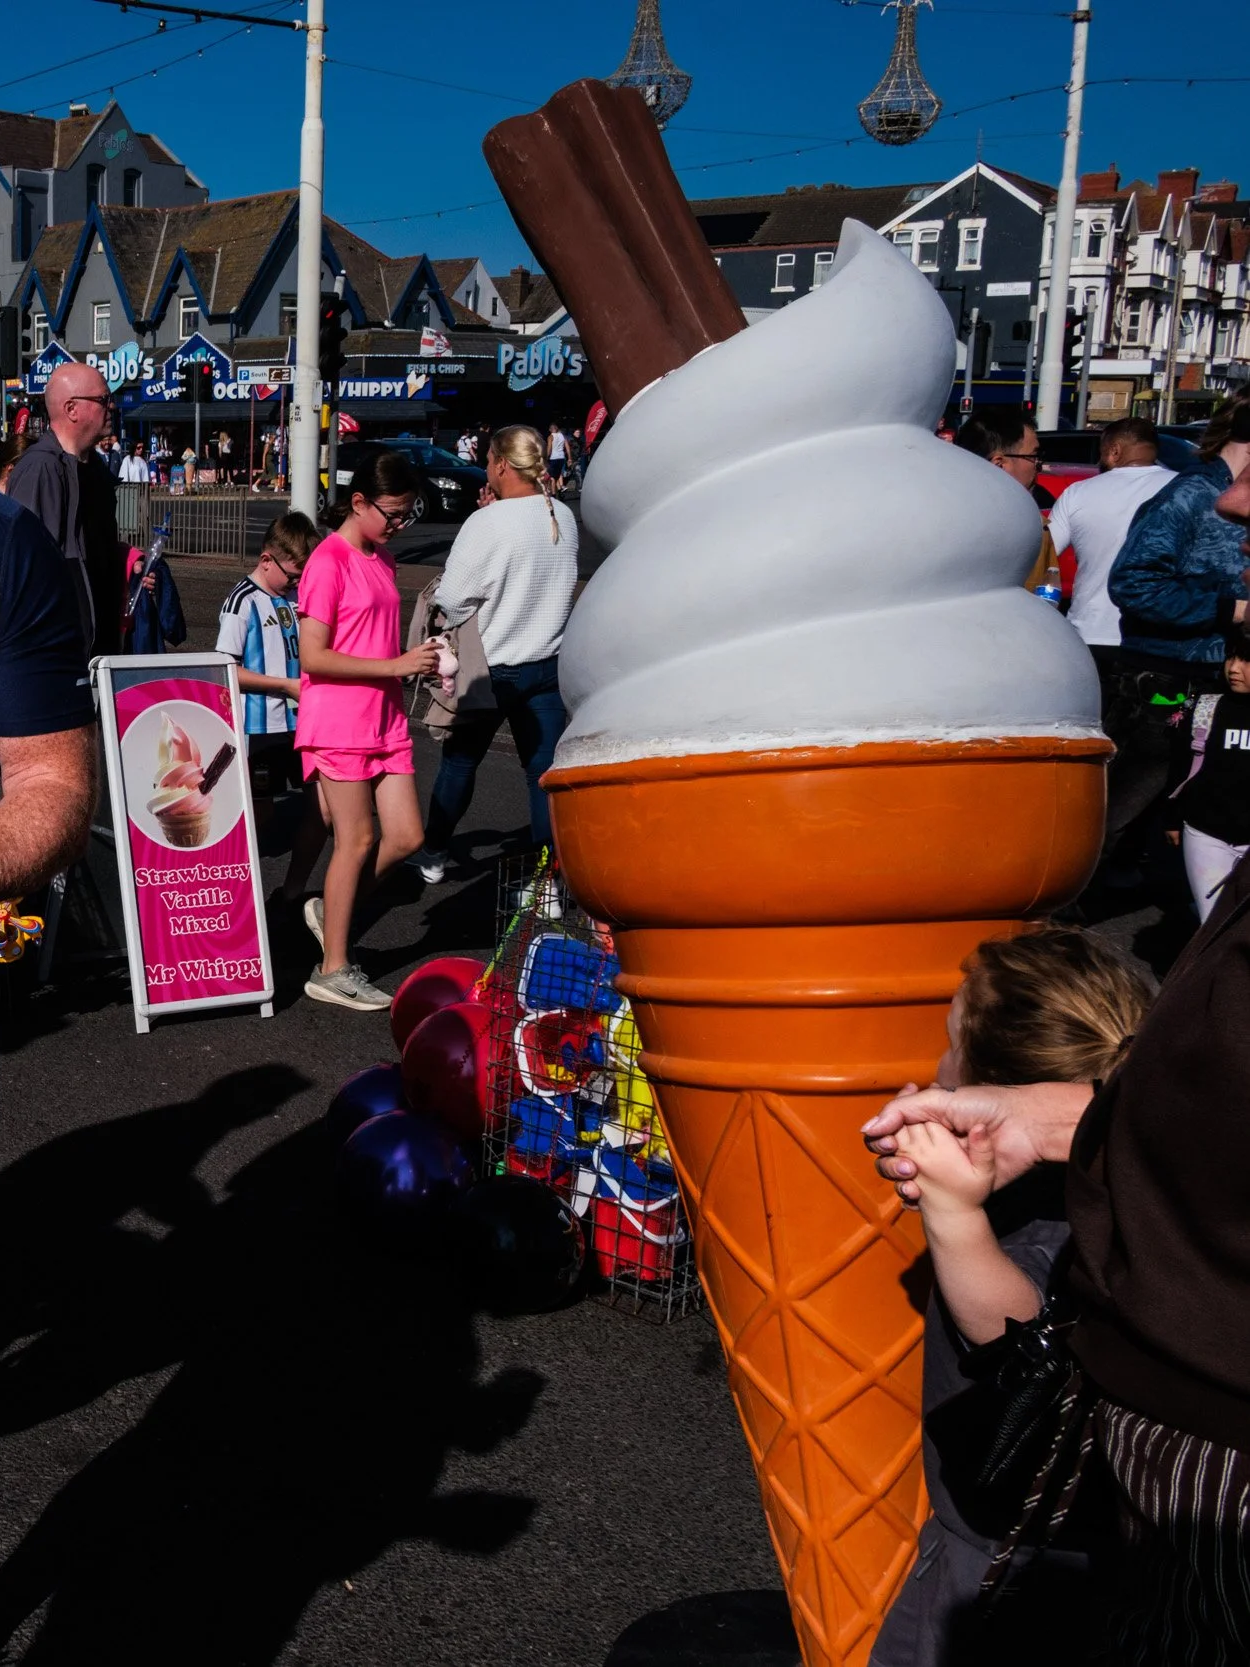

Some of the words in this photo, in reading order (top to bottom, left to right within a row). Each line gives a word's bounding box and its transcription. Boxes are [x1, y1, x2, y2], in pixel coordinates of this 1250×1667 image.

[86, 350, 155, 381] Pablo's
[429, 364, 436, 374] &
[437, 364, 465, 374] CHIPS
[498, 343, 582, 376] Pablo's
[33, 375, 48, 384] FISH
[145, 381, 166, 396] CUT
[213, 382, 251, 400] OCK
[135, 863, 252, 887] Strawberry
[161, 888, 233, 910] Vanilla
[170, 912, 230, 935] Mixed
[145, 963, 176, 986] Mr
[180, 957, 264, 983] Whippy
